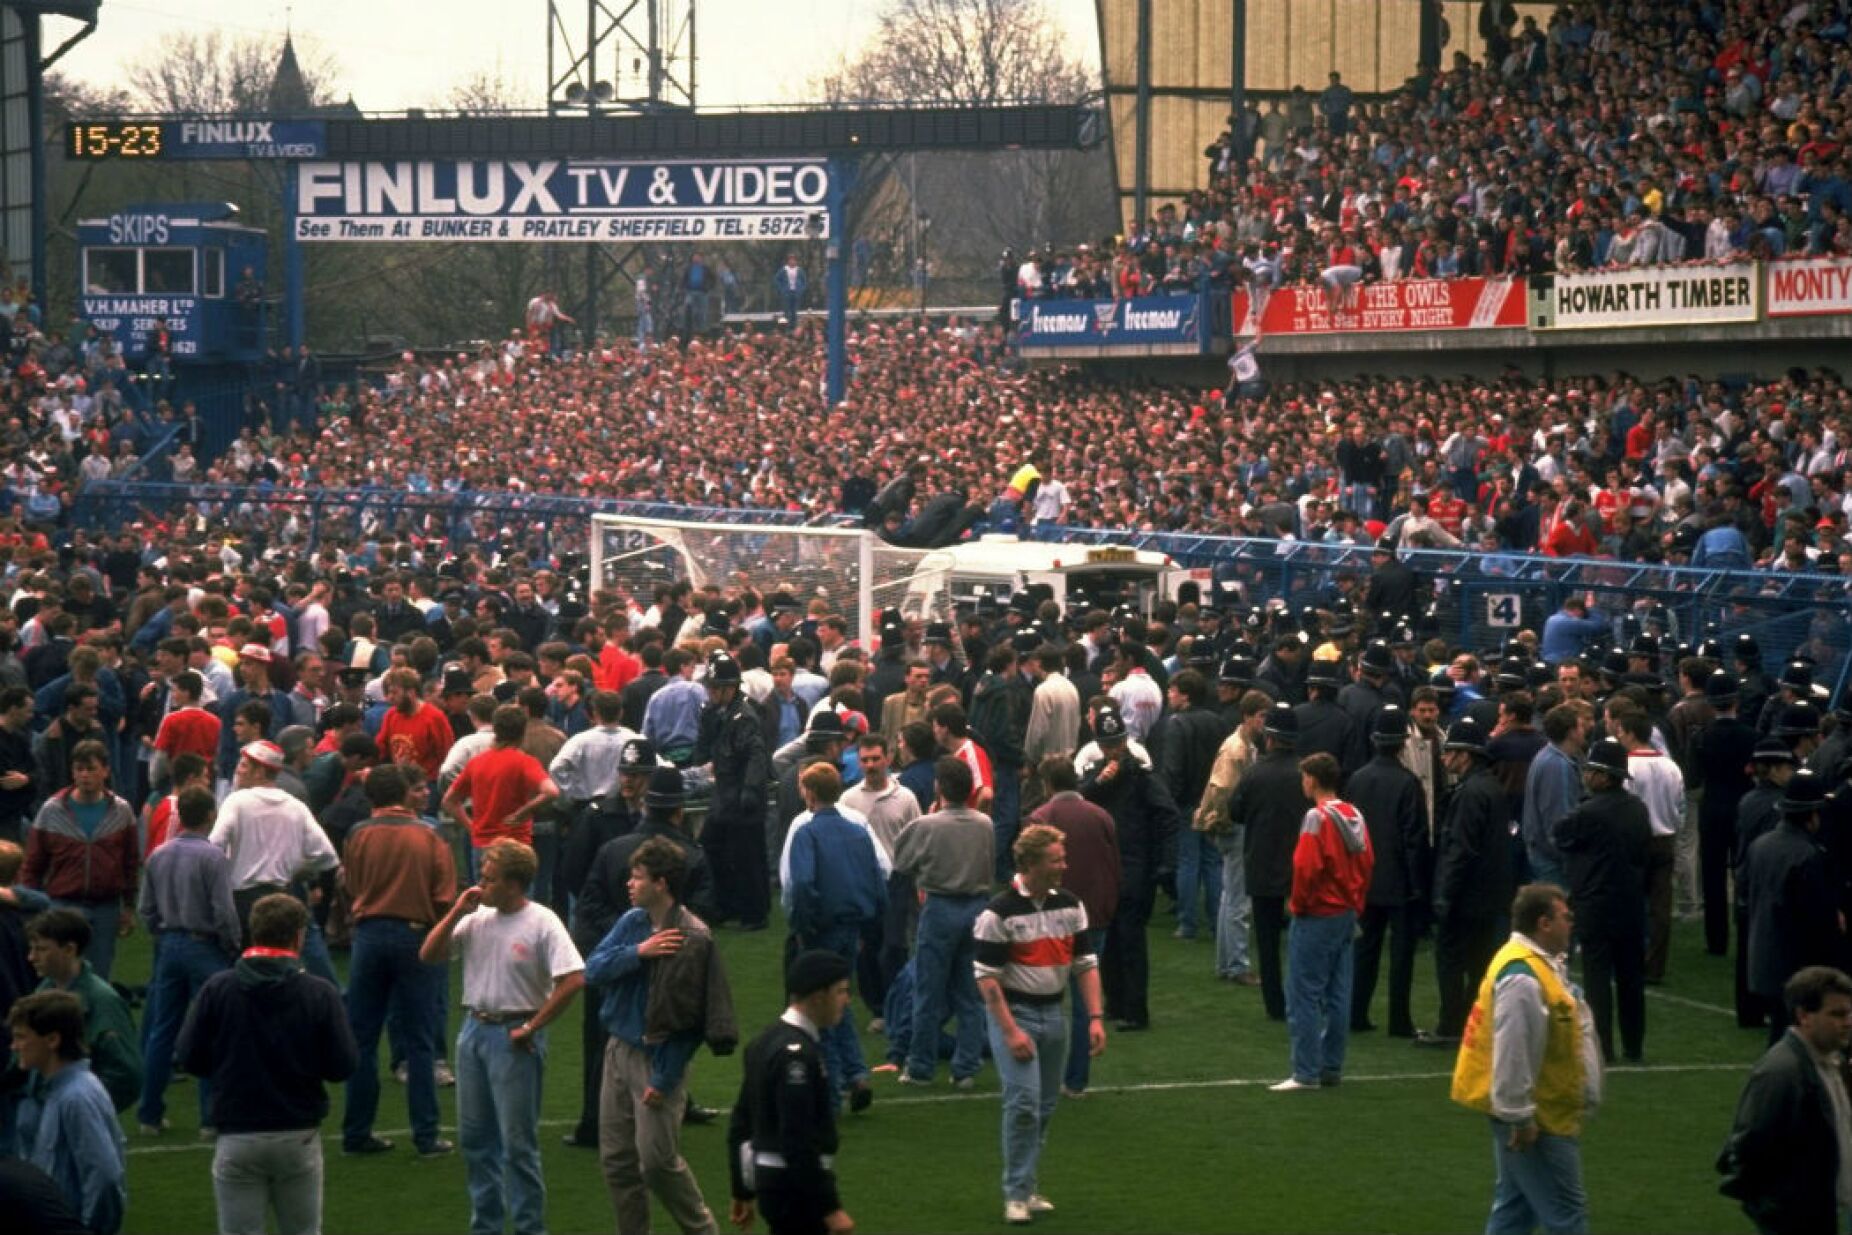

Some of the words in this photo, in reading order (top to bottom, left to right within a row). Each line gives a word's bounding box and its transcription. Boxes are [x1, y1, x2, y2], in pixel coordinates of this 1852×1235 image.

[181, 122, 273, 144] FINLUX
[298, 161, 562, 214] FINLUX
[568, 168, 628, 206] TV
[648, 167, 677, 205] &
[692, 166, 828, 204] VIDEO
[110, 214, 168, 243] SKIPS
[299, 220, 331, 237] See
[339, 219, 383, 237] Them
[392, 219, 410, 237] At
[422, 219, 491, 237] BUNKER
[497, 219, 509, 237] &
[523, 218, 601, 237] PRATLEY
[608, 218, 705, 236] SHEFFIELD
[1366, 285, 1399, 308] THE
[1405, 282, 1450, 307] OWLS
[1558, 282, 1660, 314] HOWARTH
[1666, 276, 1751, 308] TIMBER
[1774, 267, 1851, 302] MONTY
[1362, 309, 1405, 327] EVERY
[1410, 307, 1454, 326] NIGHT
[1493, 597, 1518, 623] 4
